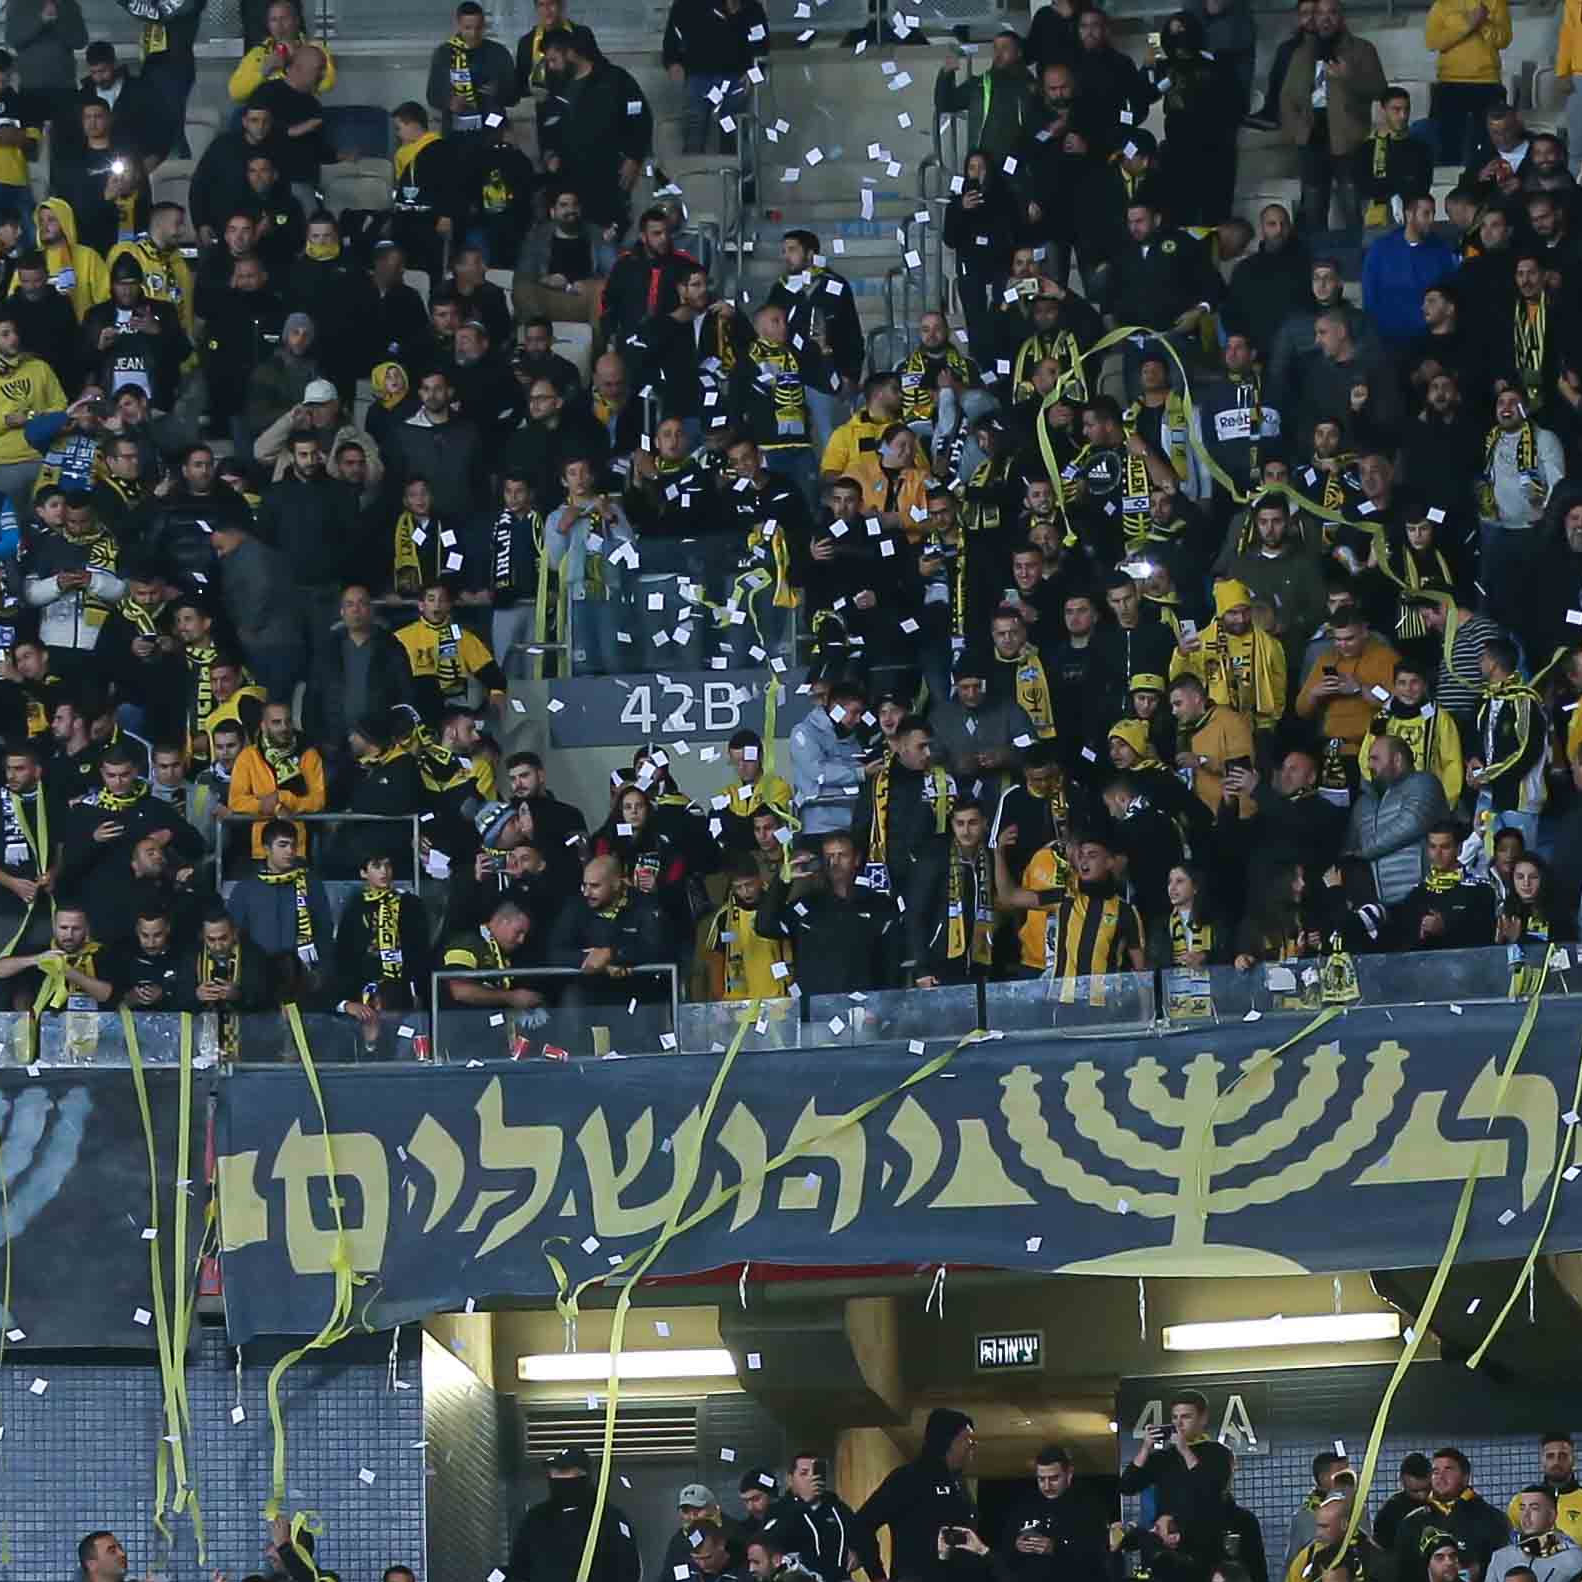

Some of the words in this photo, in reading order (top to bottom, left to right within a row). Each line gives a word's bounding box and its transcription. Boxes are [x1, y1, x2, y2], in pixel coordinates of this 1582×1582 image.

[1219, 411, 1279, 429] Reebk
[620, 681, 742, 738] 42B
[268, 1074, 944, 1277] ירושלים
[997, 1336, 1039, 1367] יציאה
[1132, 1392, 1260, 1452] 4A
